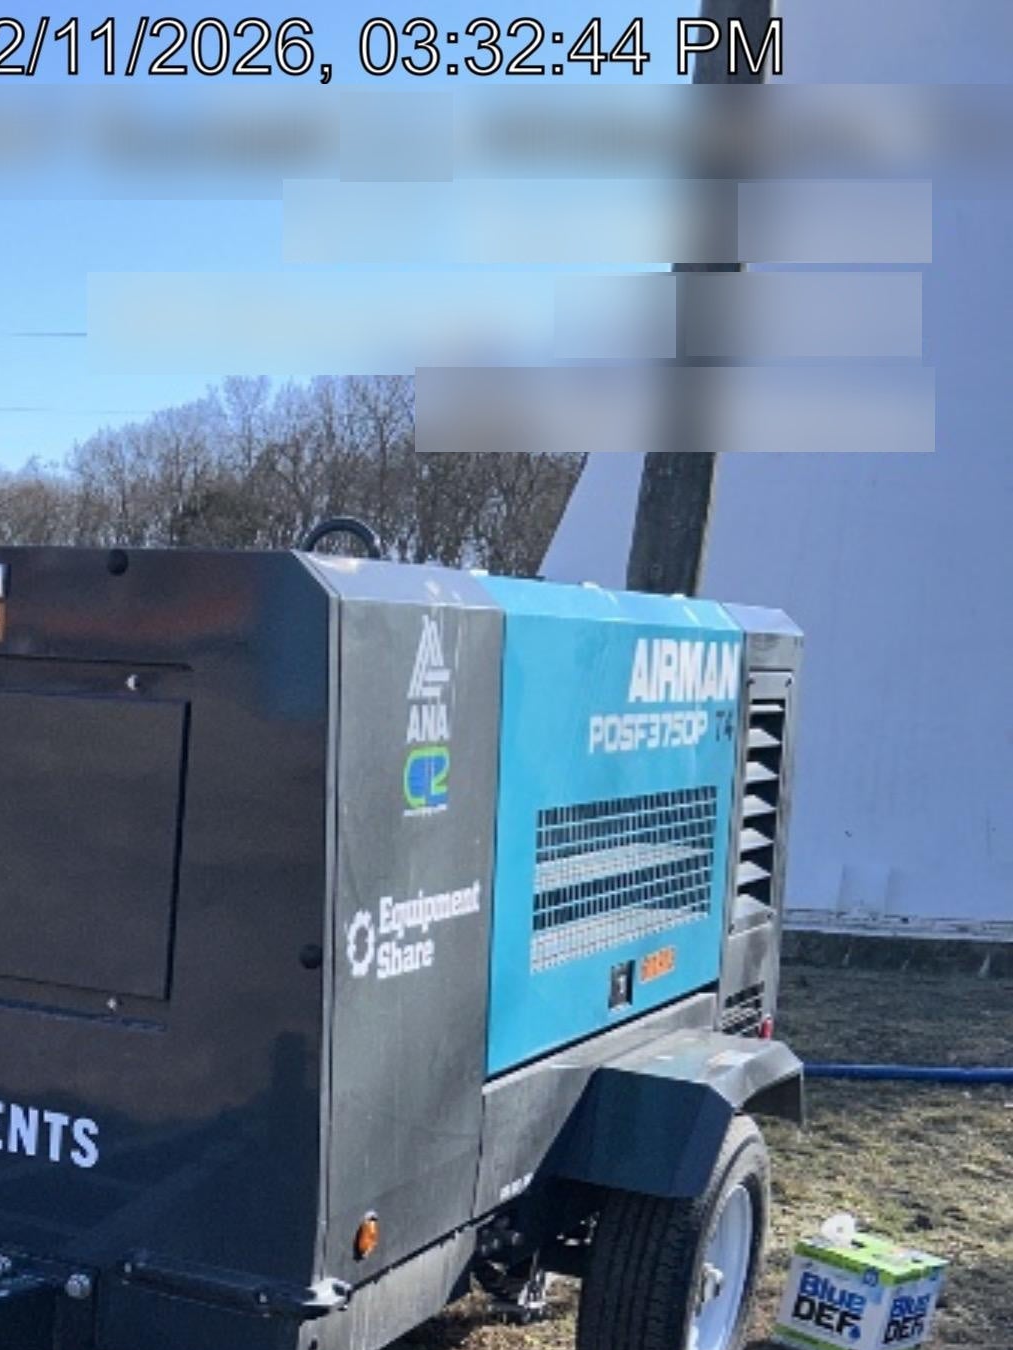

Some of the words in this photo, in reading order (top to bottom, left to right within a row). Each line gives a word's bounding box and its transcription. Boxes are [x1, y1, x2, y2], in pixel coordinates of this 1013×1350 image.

[627, 638, 741, 703] AIRMAN
[406, 703, 450, 744] ANA
[378, 878, 481, 940] Equipment
[376, 938, 436, 980] Share
[791, 1293, 863, 1336] DEF
[799, 1271, 867, 1317] Blue
